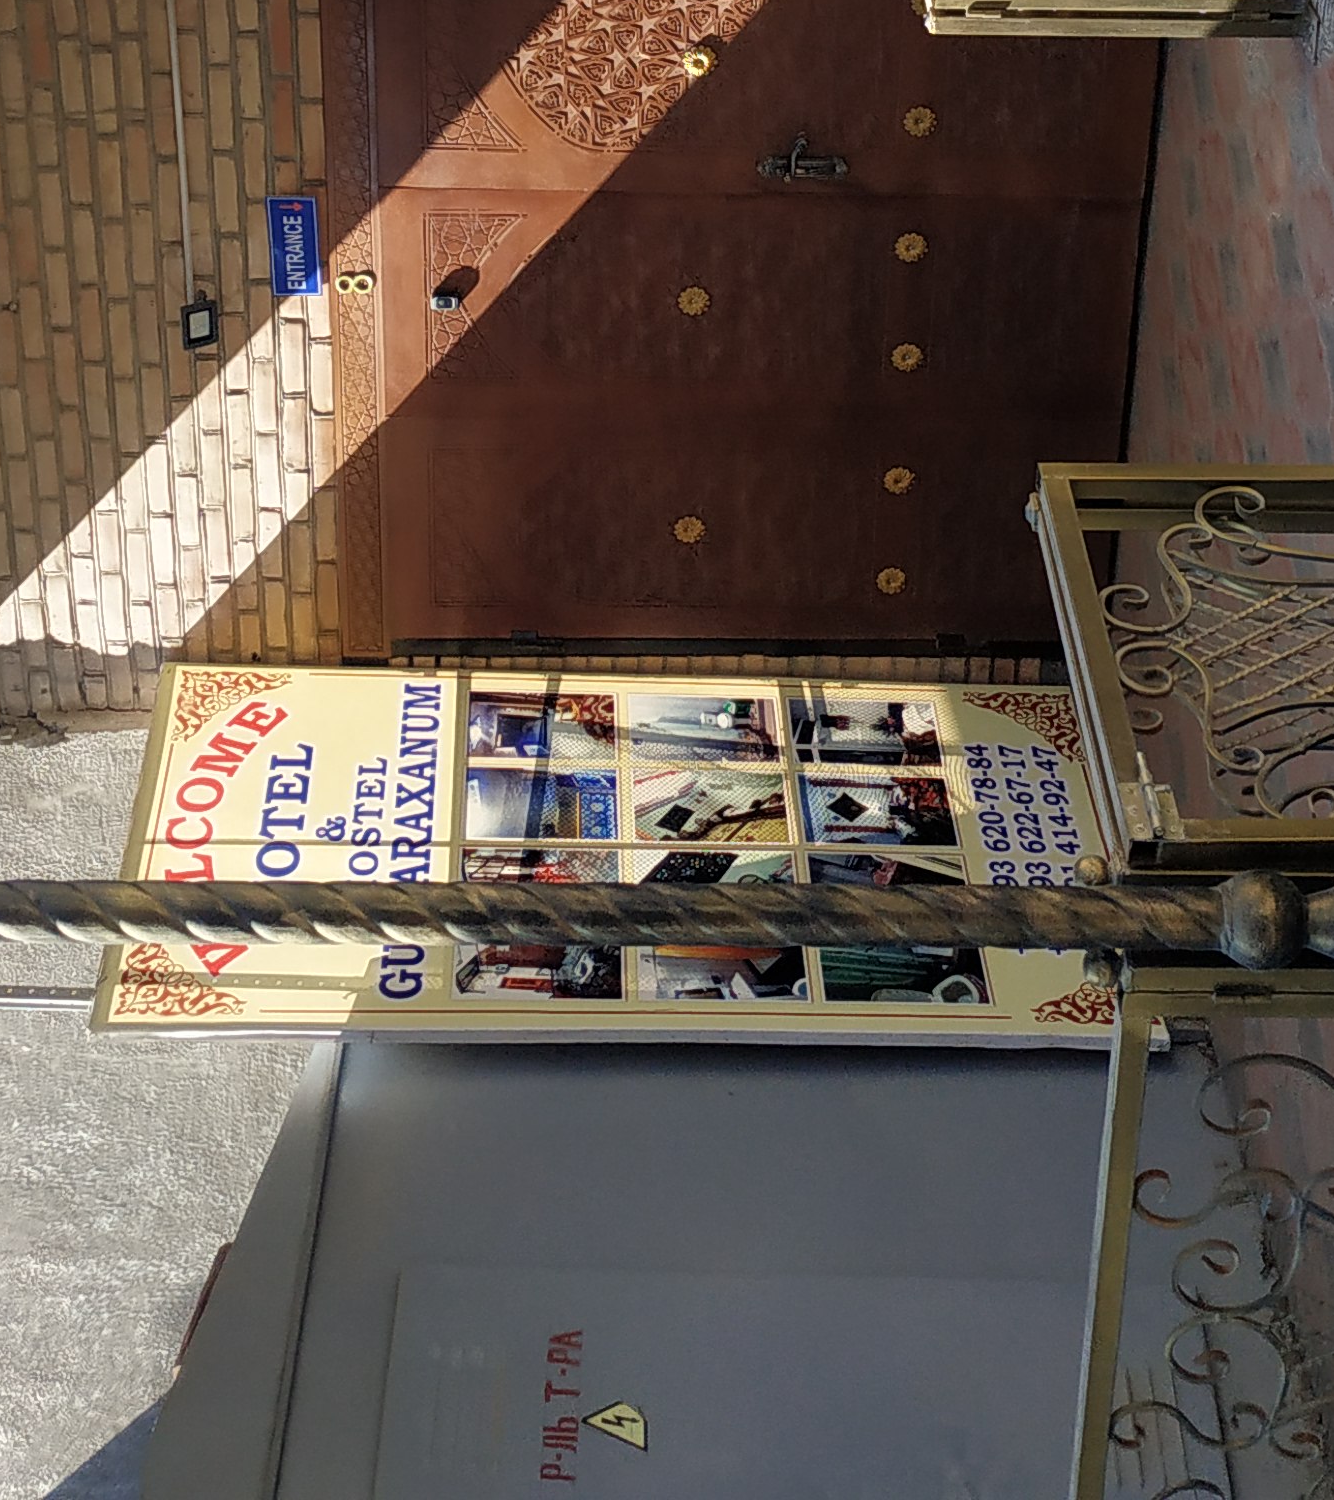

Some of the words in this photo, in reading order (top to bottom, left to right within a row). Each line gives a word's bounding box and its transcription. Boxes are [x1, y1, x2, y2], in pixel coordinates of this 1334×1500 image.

[283, 215, 307, 290] ENTRANCE
[335, 275, 373, 294] 8
[164, 702, 288, 977] WLCOME
[253, 742, 314, 878] OTEL
[316, 816, 346, 842] &
[348, 756, 388, 883] OSTEL
[378, 682, 441, 1000] GUARAXANUM
[963, 744, 1011, 853] 620-78-84
[998, 744, 1046, 854] 622-67-17
[1031, 745, 1080, 855] 414-92-47
